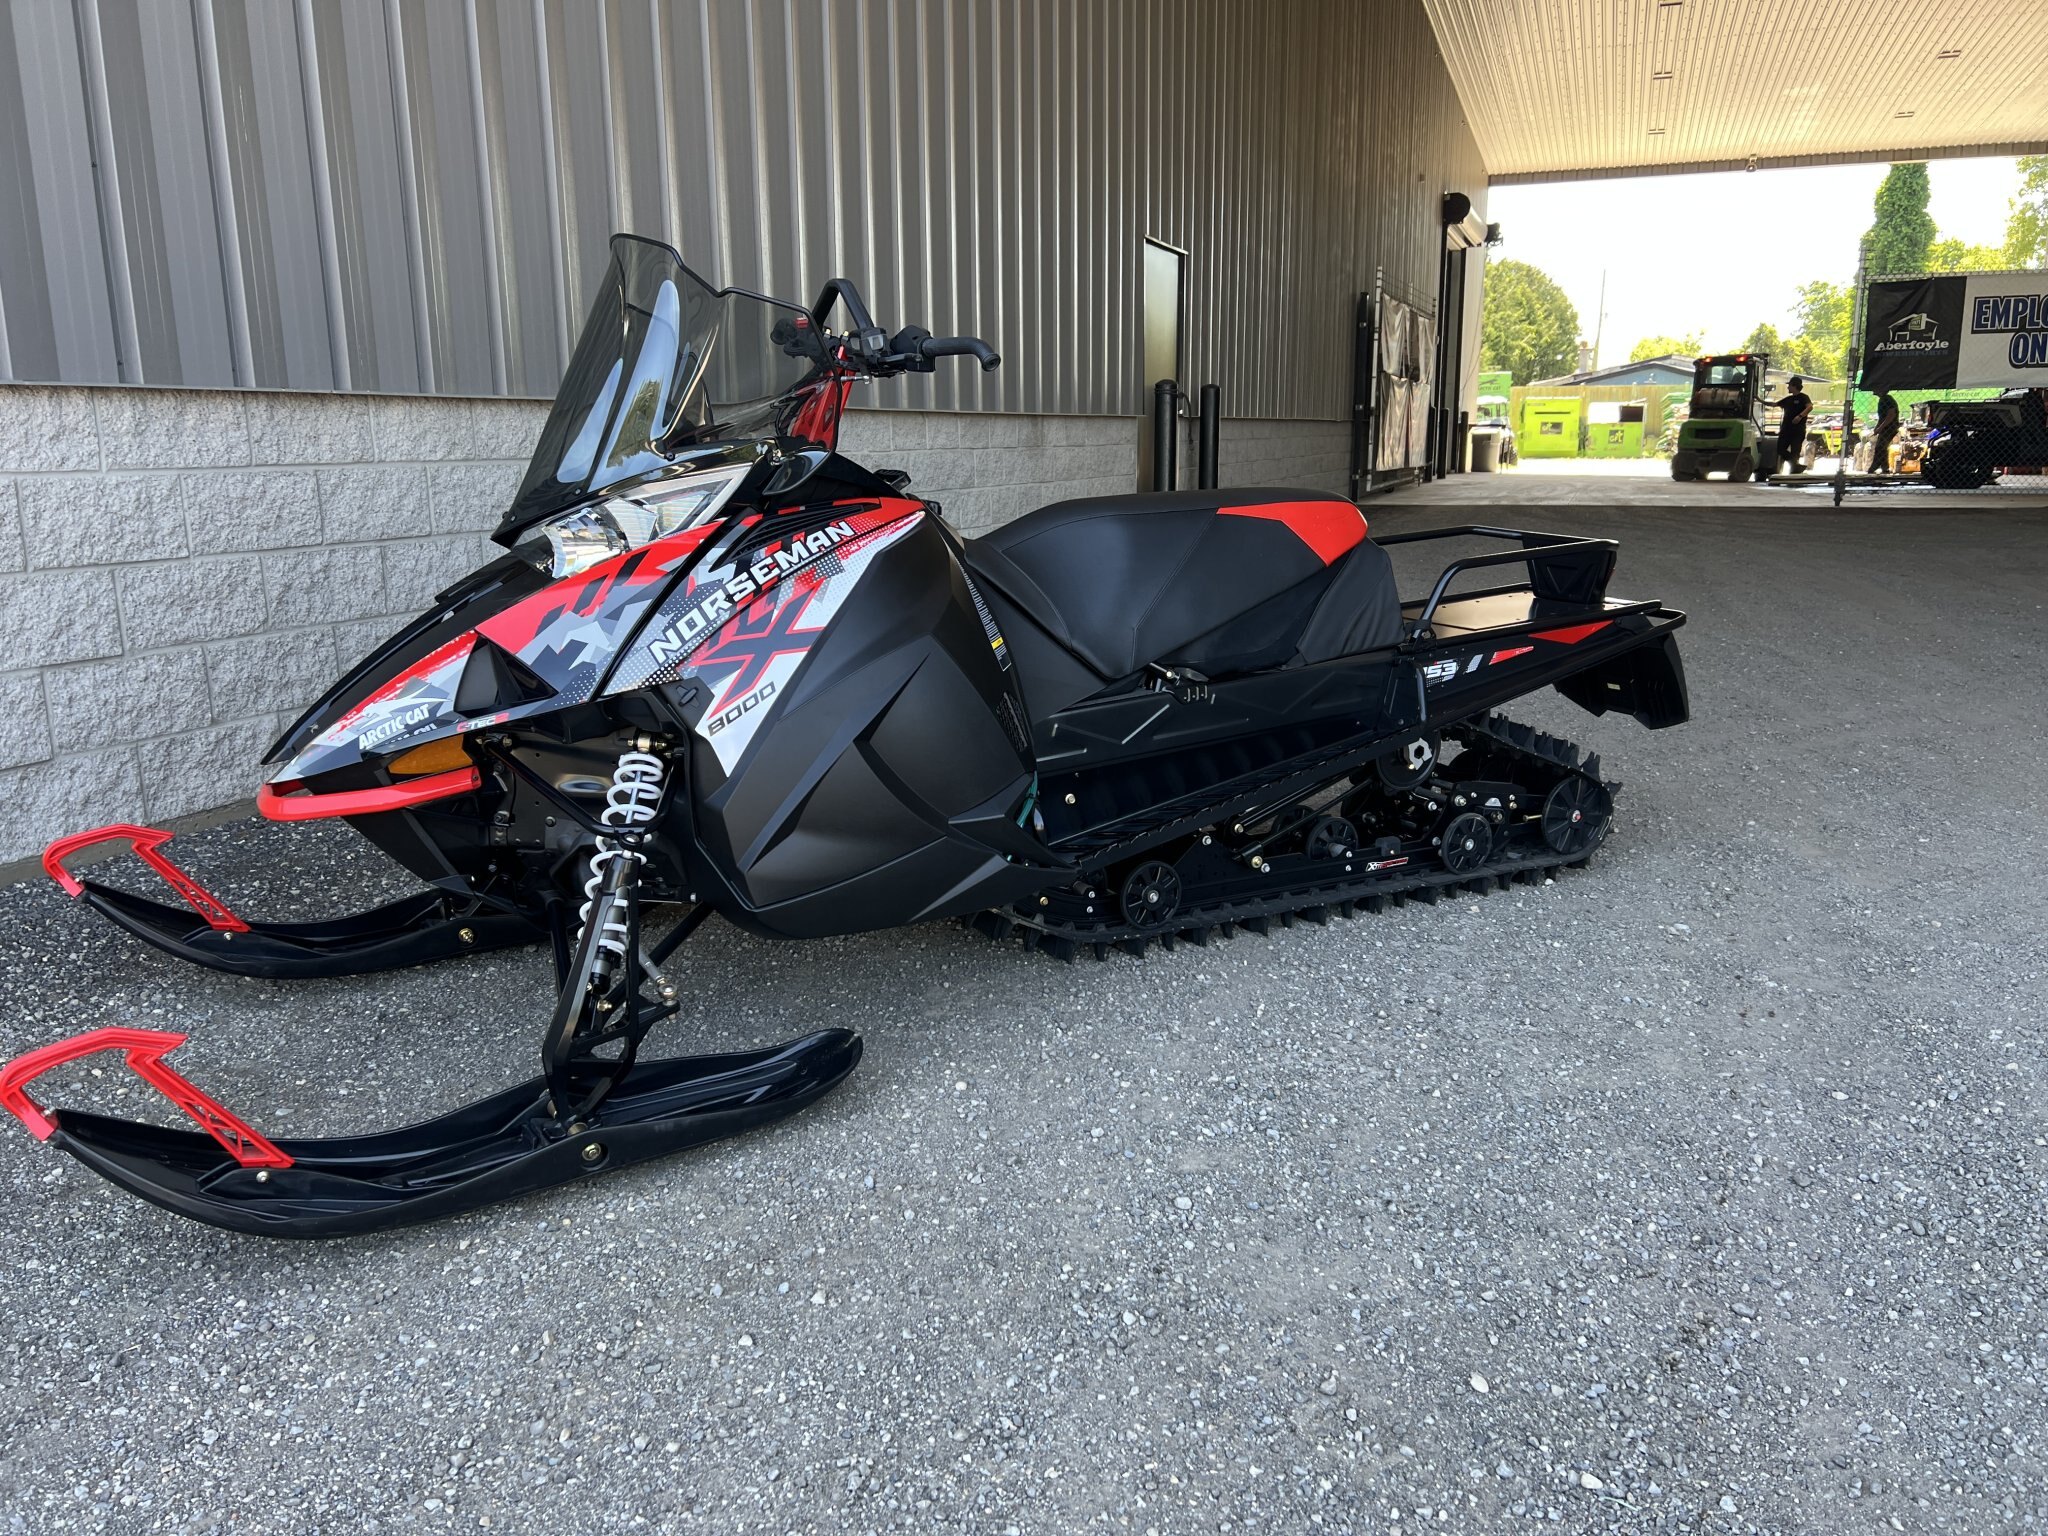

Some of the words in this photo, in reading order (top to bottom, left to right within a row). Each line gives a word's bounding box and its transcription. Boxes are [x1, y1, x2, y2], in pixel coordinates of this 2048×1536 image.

[1874, 340, 1949, 351] Aberfoyle
[648, 521, 857, 664] NORSEMAN
[359, 714, 405, 750] ARCTIC
[406, 704, 430, 726] CAT
